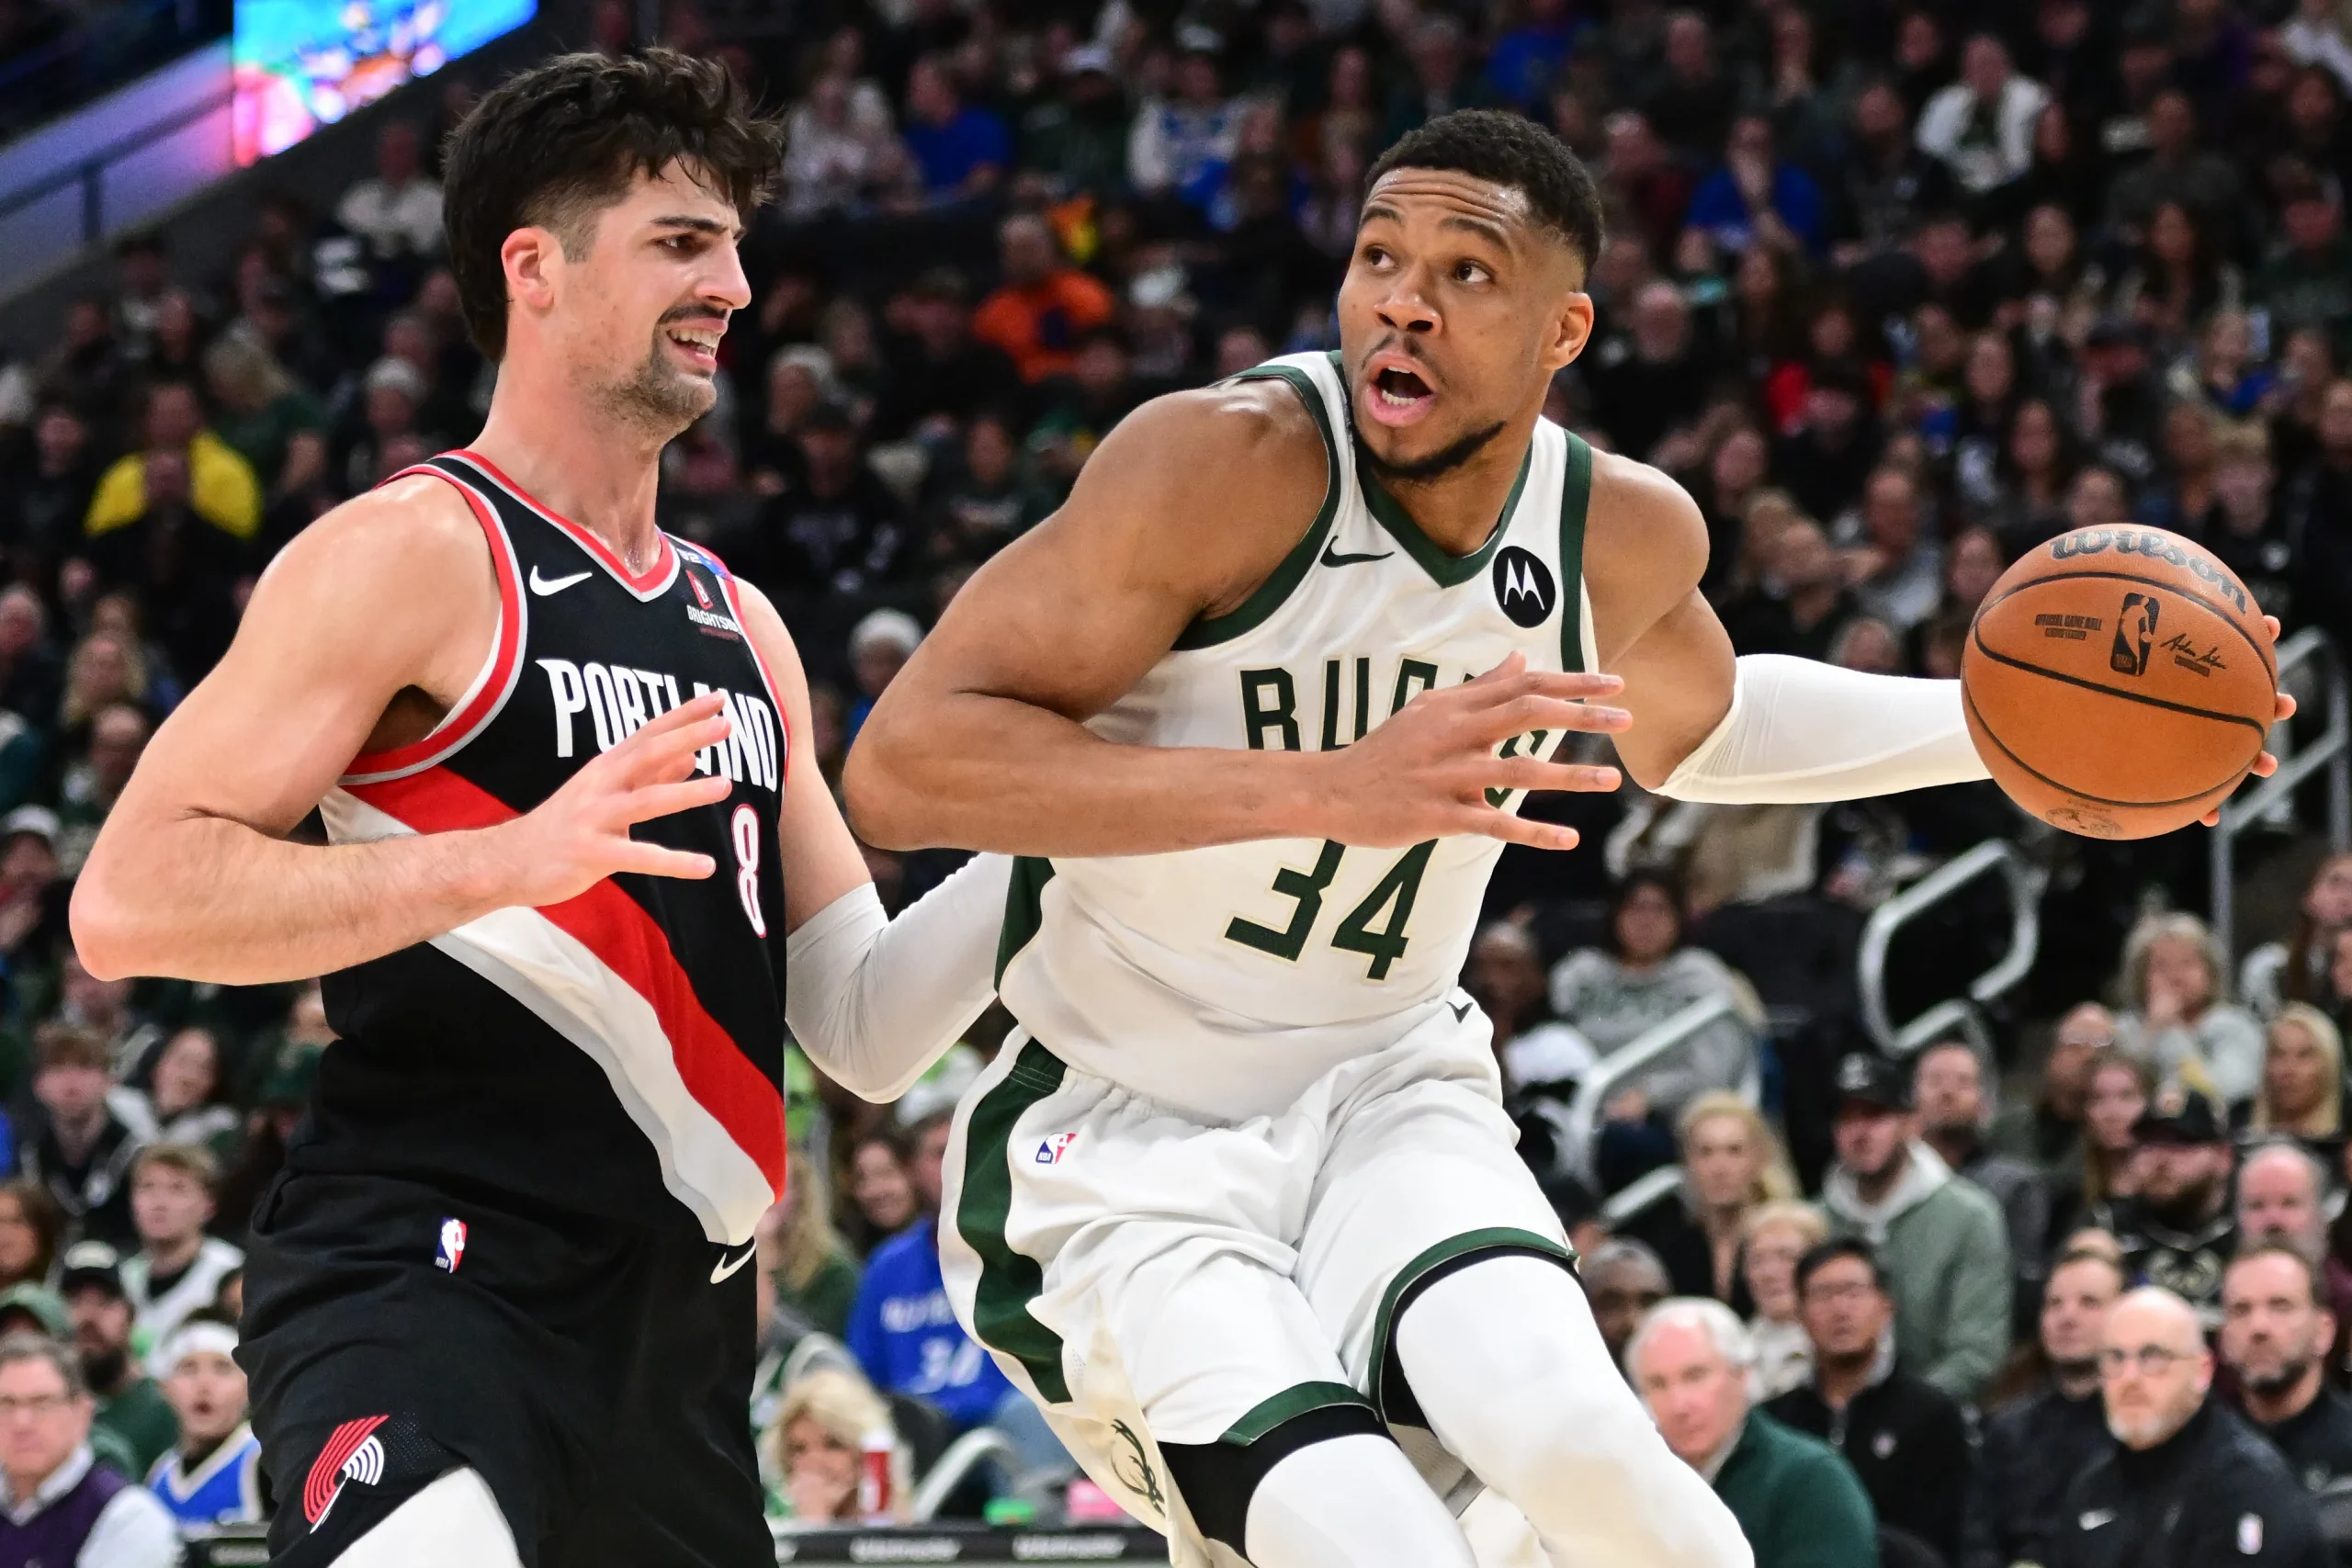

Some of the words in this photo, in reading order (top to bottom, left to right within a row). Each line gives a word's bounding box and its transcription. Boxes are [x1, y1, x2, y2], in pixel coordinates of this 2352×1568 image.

[2048, 529, 2246, 615] Wilson
[1239, 656, 1549, 810] BUC
[731, 804, 766, 938] 8
[1223, 838, 1439, 981] 34
[435, 1256, 449, 1269] NBA
